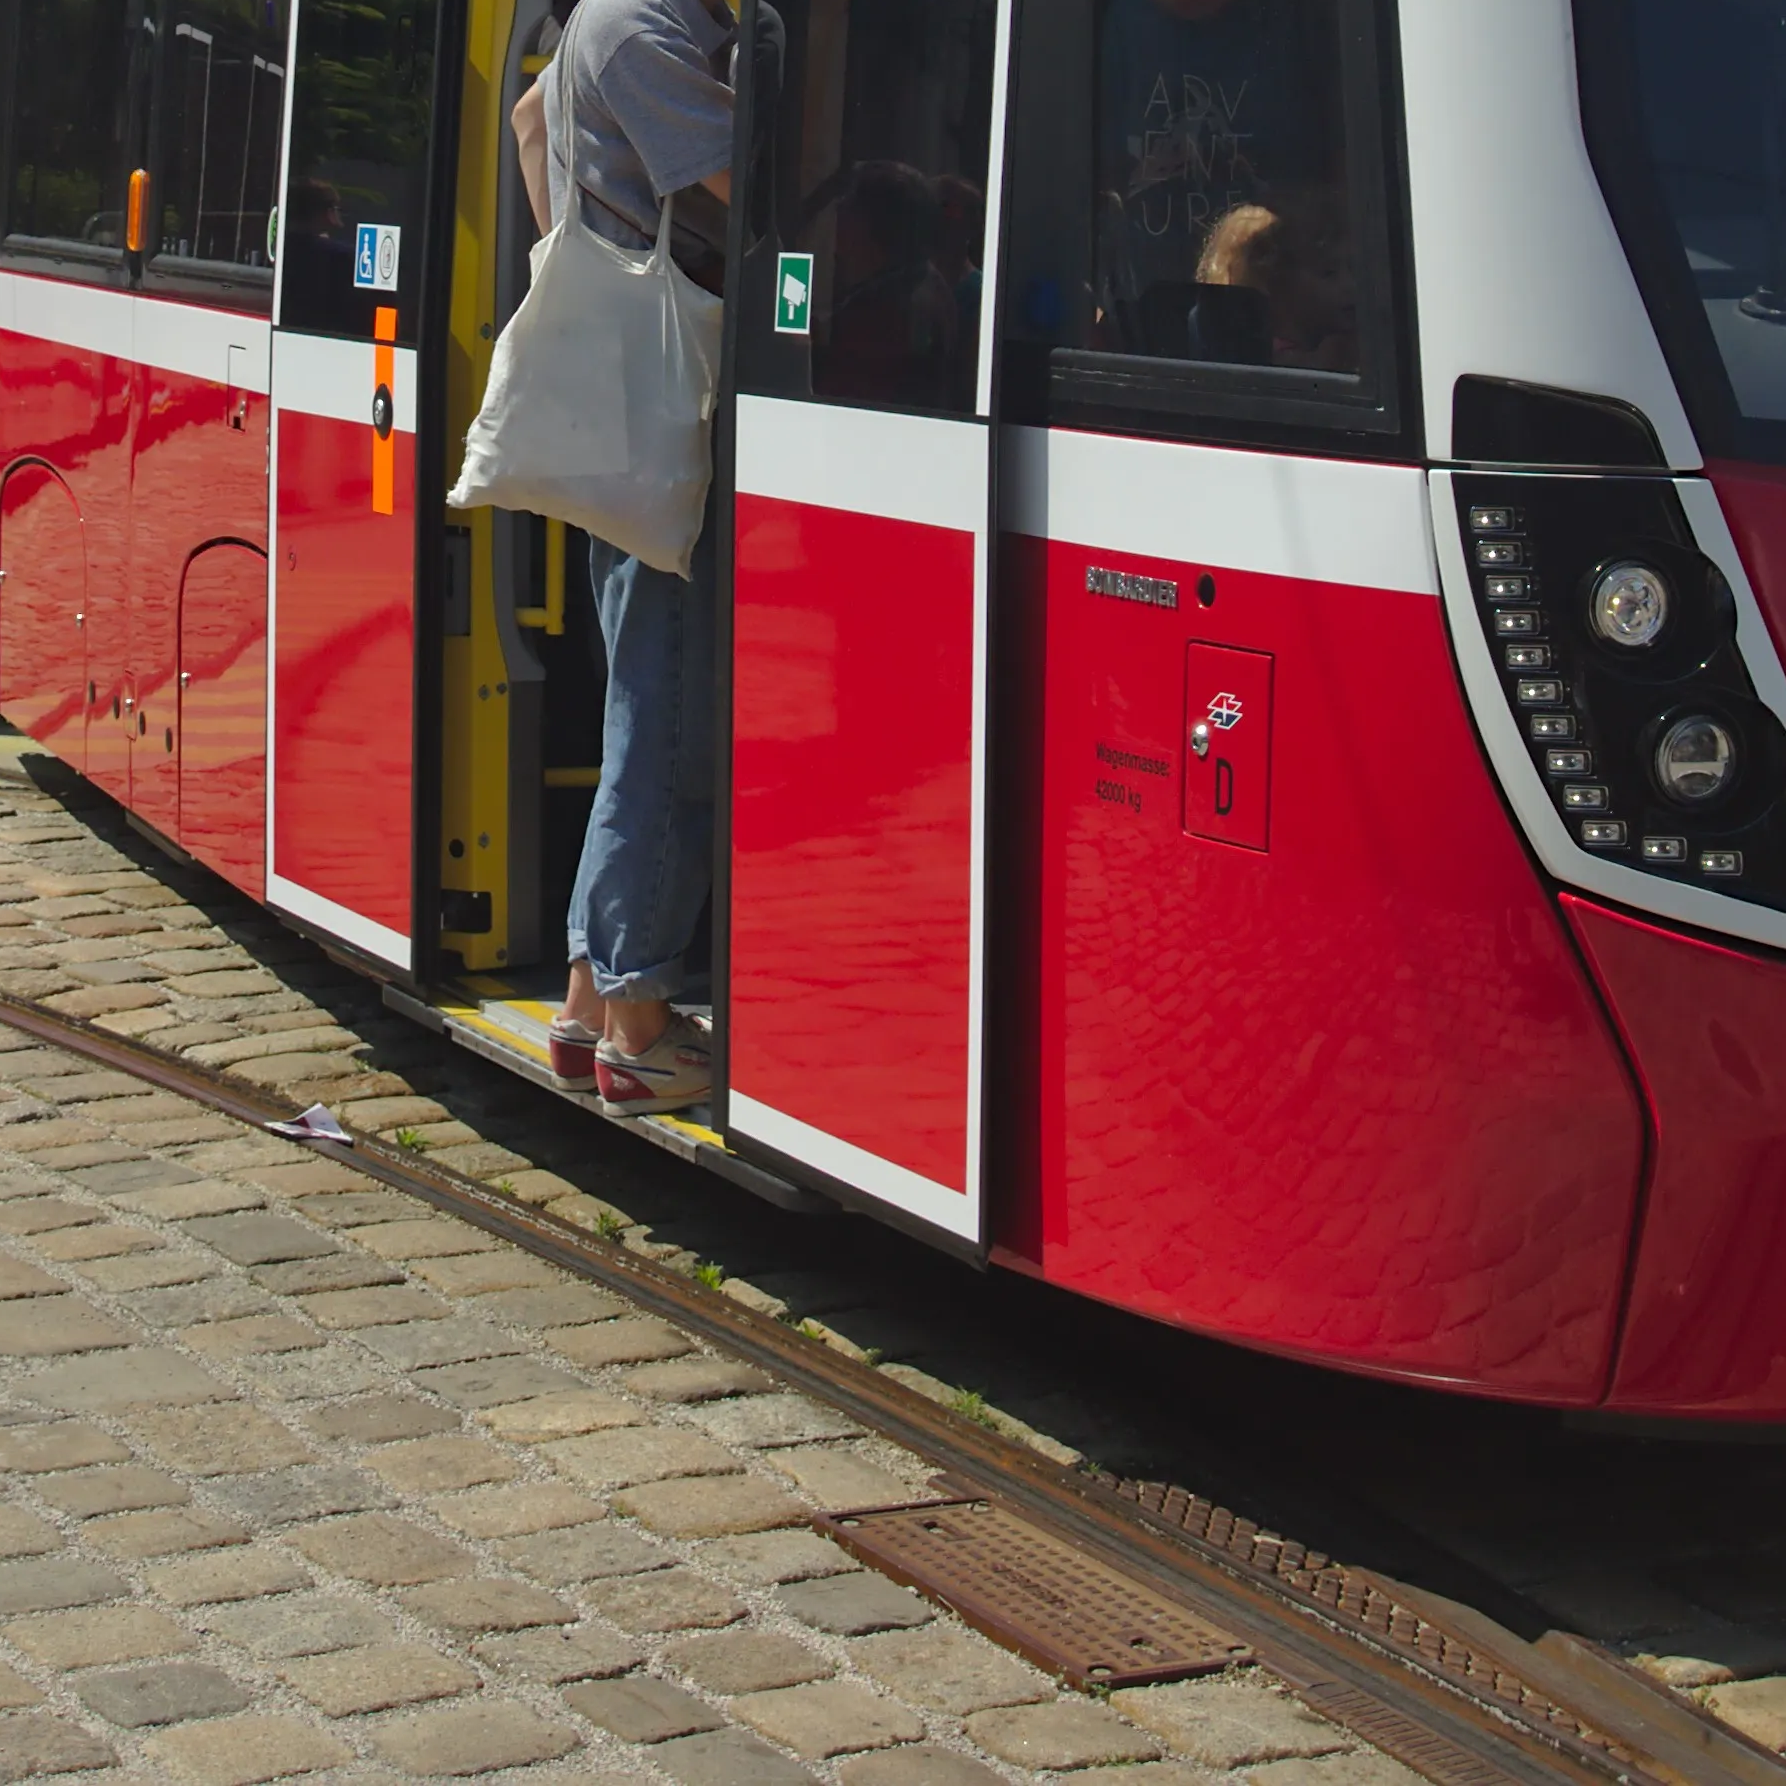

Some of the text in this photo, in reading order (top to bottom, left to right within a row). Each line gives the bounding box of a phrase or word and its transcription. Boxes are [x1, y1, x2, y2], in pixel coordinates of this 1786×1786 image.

[1143, 71, 1248, 123] ADV
[1086, 565, 1178, 608] BOMBARDIER
[1128, 786, 1142, 814] kg
[1215, 757, 1234, 816] D
